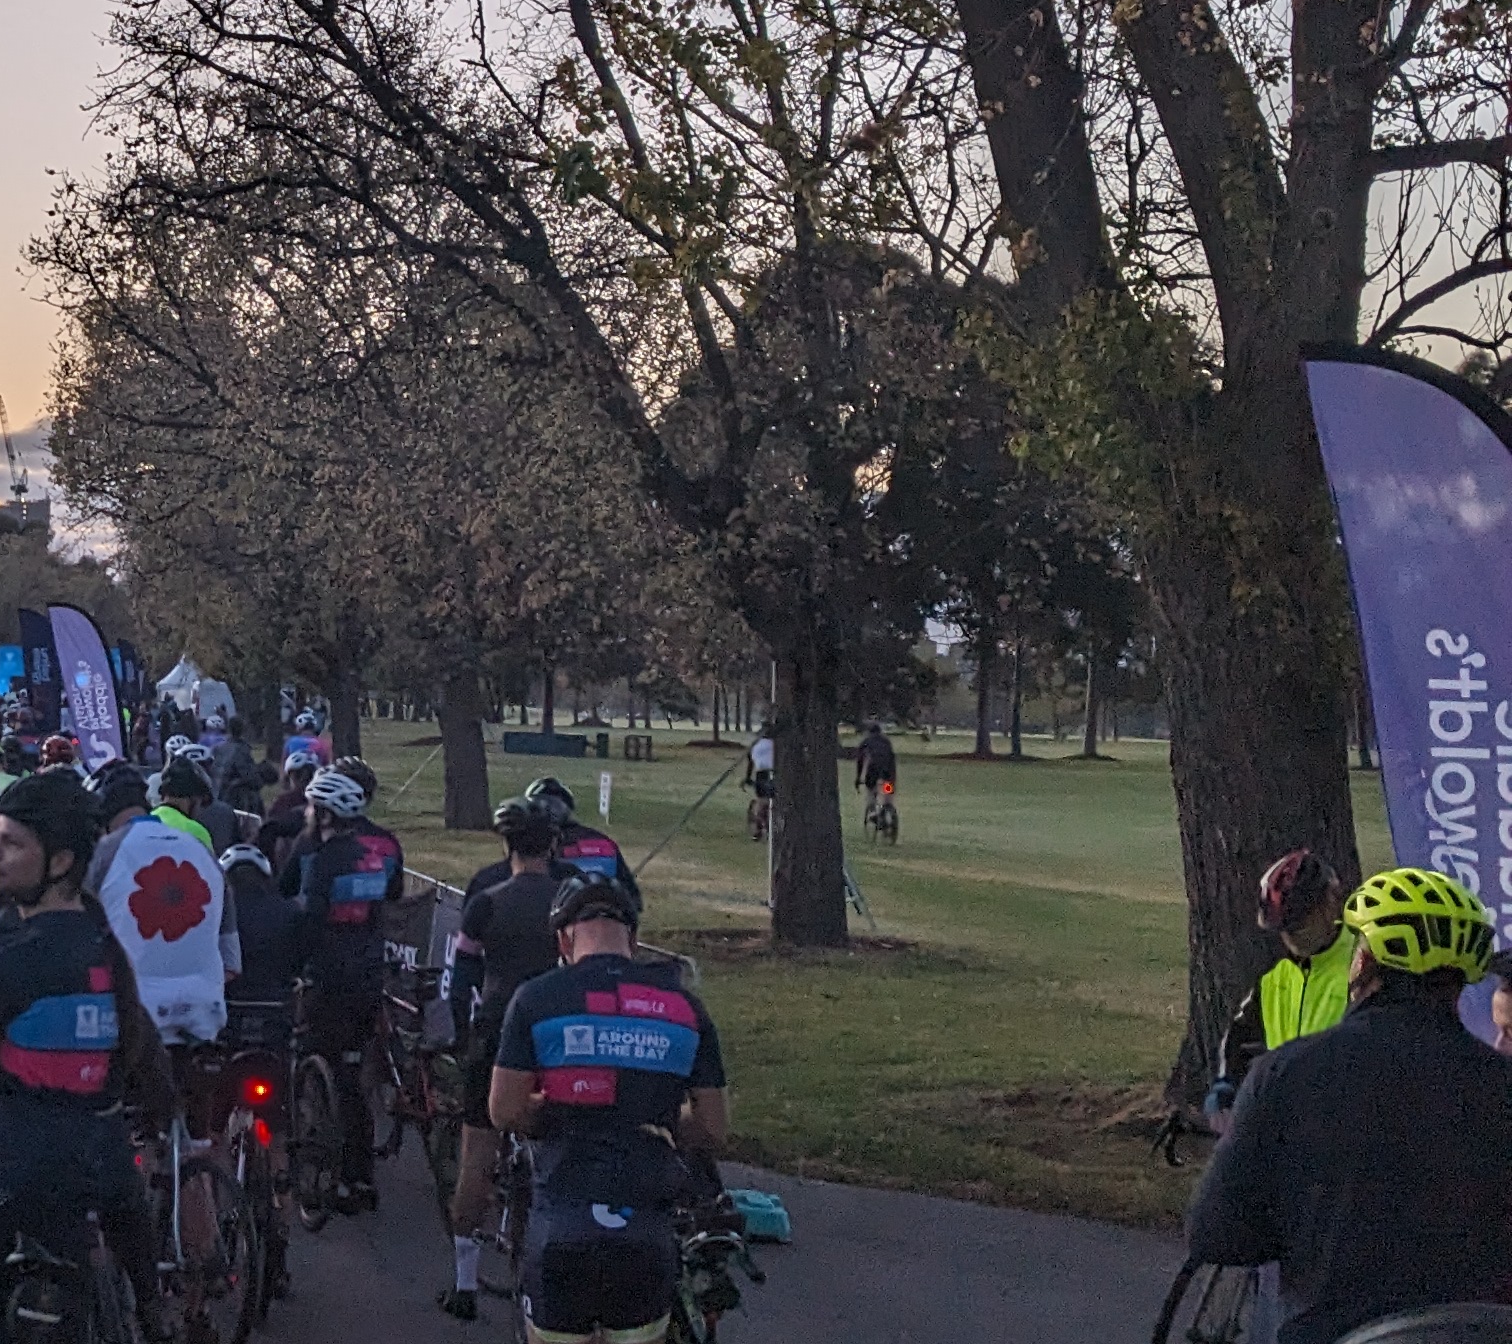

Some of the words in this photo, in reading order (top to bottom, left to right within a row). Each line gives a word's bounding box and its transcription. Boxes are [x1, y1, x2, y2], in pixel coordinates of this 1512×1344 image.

[597, 1031, 671, 1050] AROUND
[597, 1044, 630, 1057] THE
[634, 1046, 666, 1061] BAY
